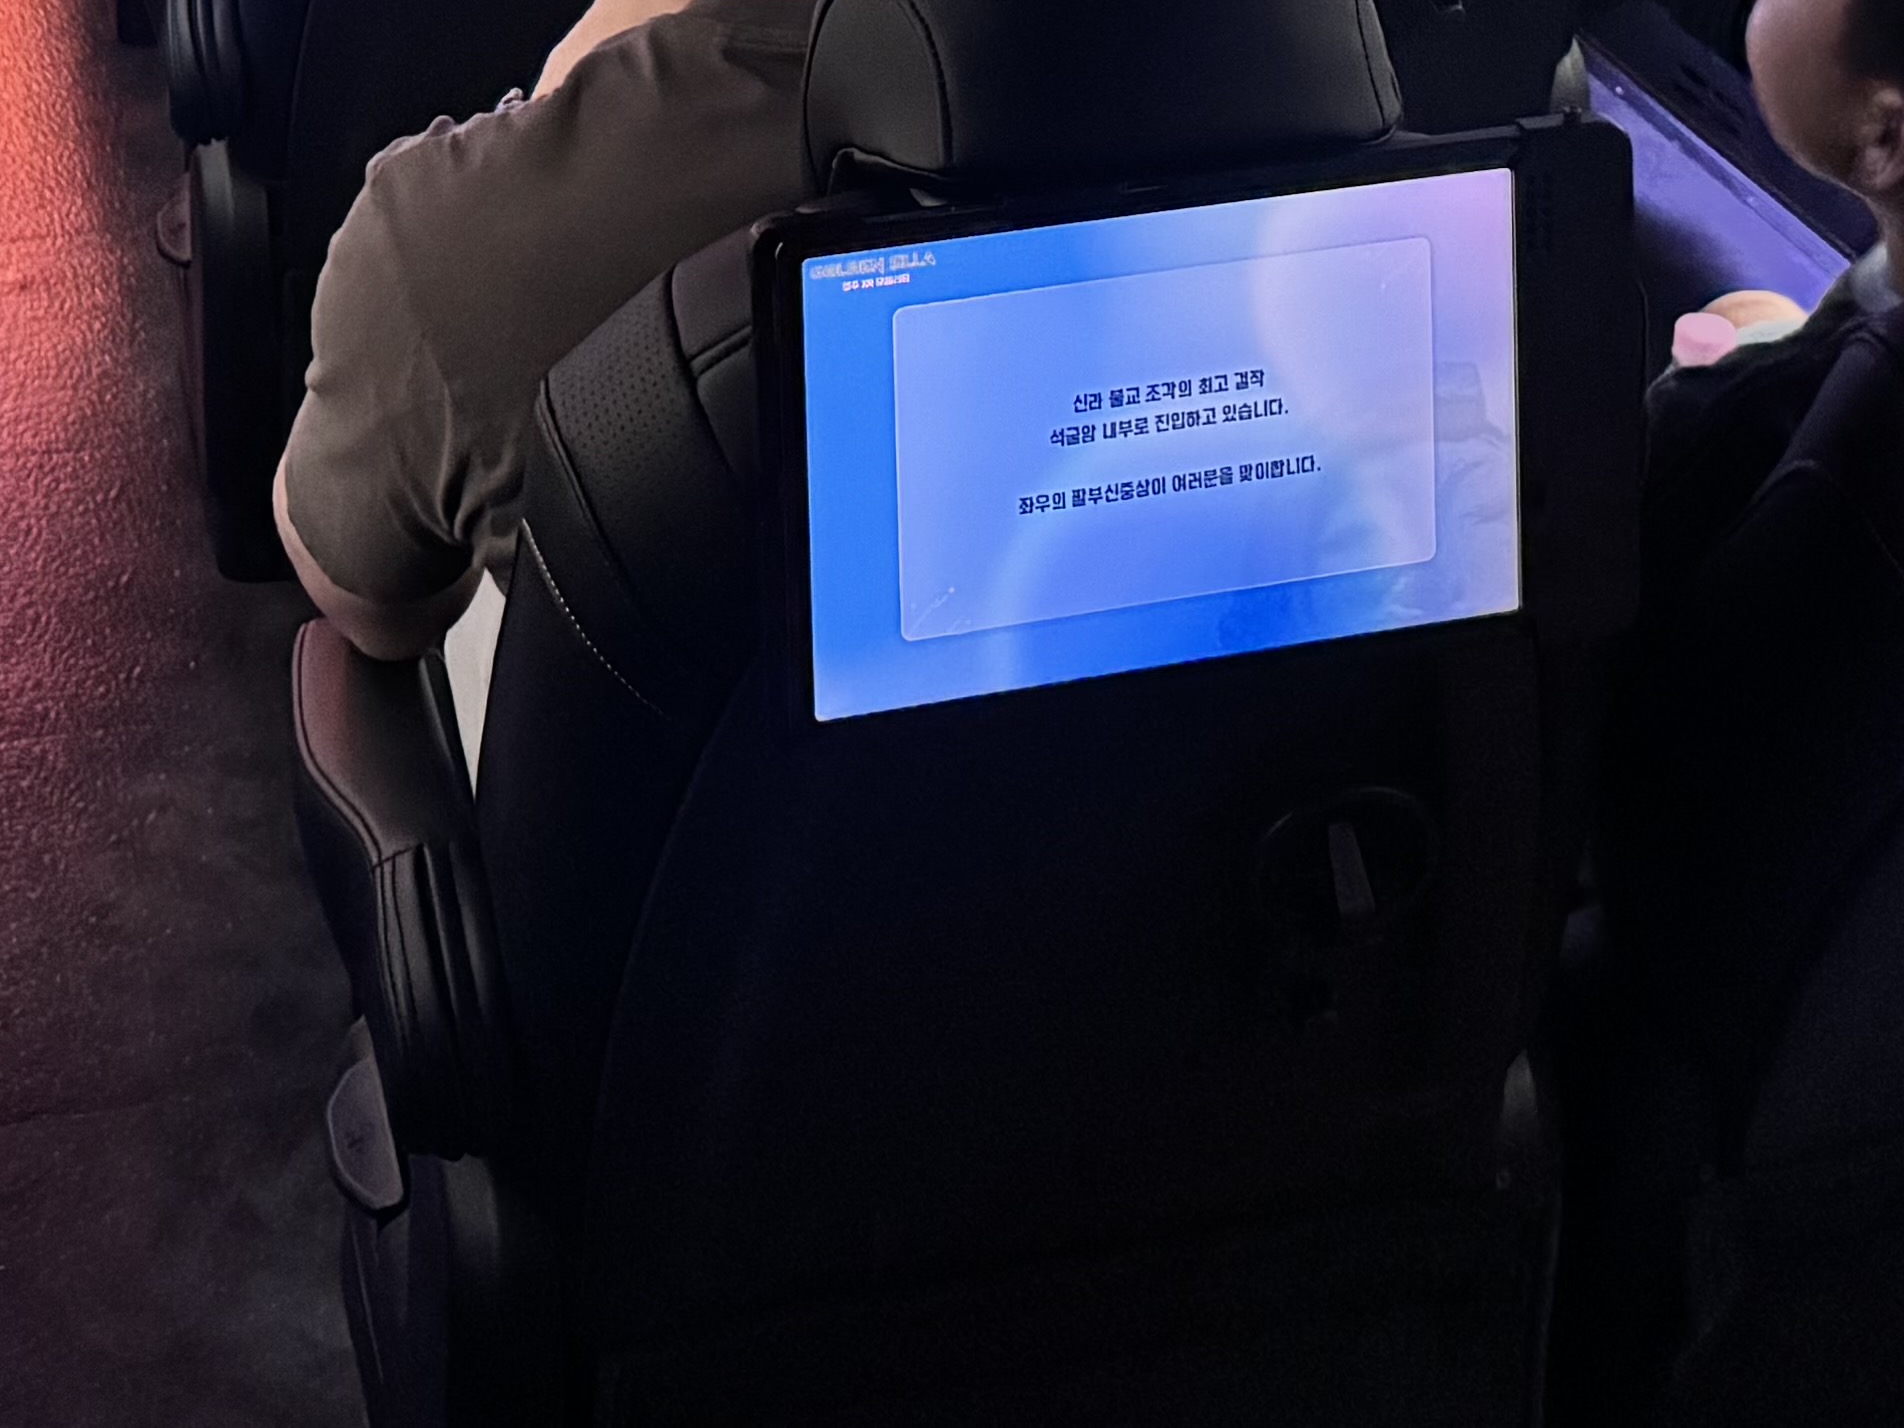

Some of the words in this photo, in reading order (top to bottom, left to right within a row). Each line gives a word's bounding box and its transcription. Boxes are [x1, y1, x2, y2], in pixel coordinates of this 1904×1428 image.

[1073, 393, 1102, 413] 신라
[1109, 387, 1140, 408] 불교
[1145, 379, 1192, 402] 조각의
[1198, 374, 1228, 395] 최고
[1234, 369, 1265, 390] 걸작
[1050, 424, 1096, 447] 석굴암
[1102, 417, 1149, 439] 내부로
[1155, 407, 1217, 433] 진입하고
[1222, 398, 1289, 424] 있습니다.
[1018, 492, 1066, 515] 좌우의
[1072, 478, 1166, 508] 팔부신중상이
[1172, 466, 1233, 493] 여러분을
[1239, 455, 1321, 481] 맞이합니다.
